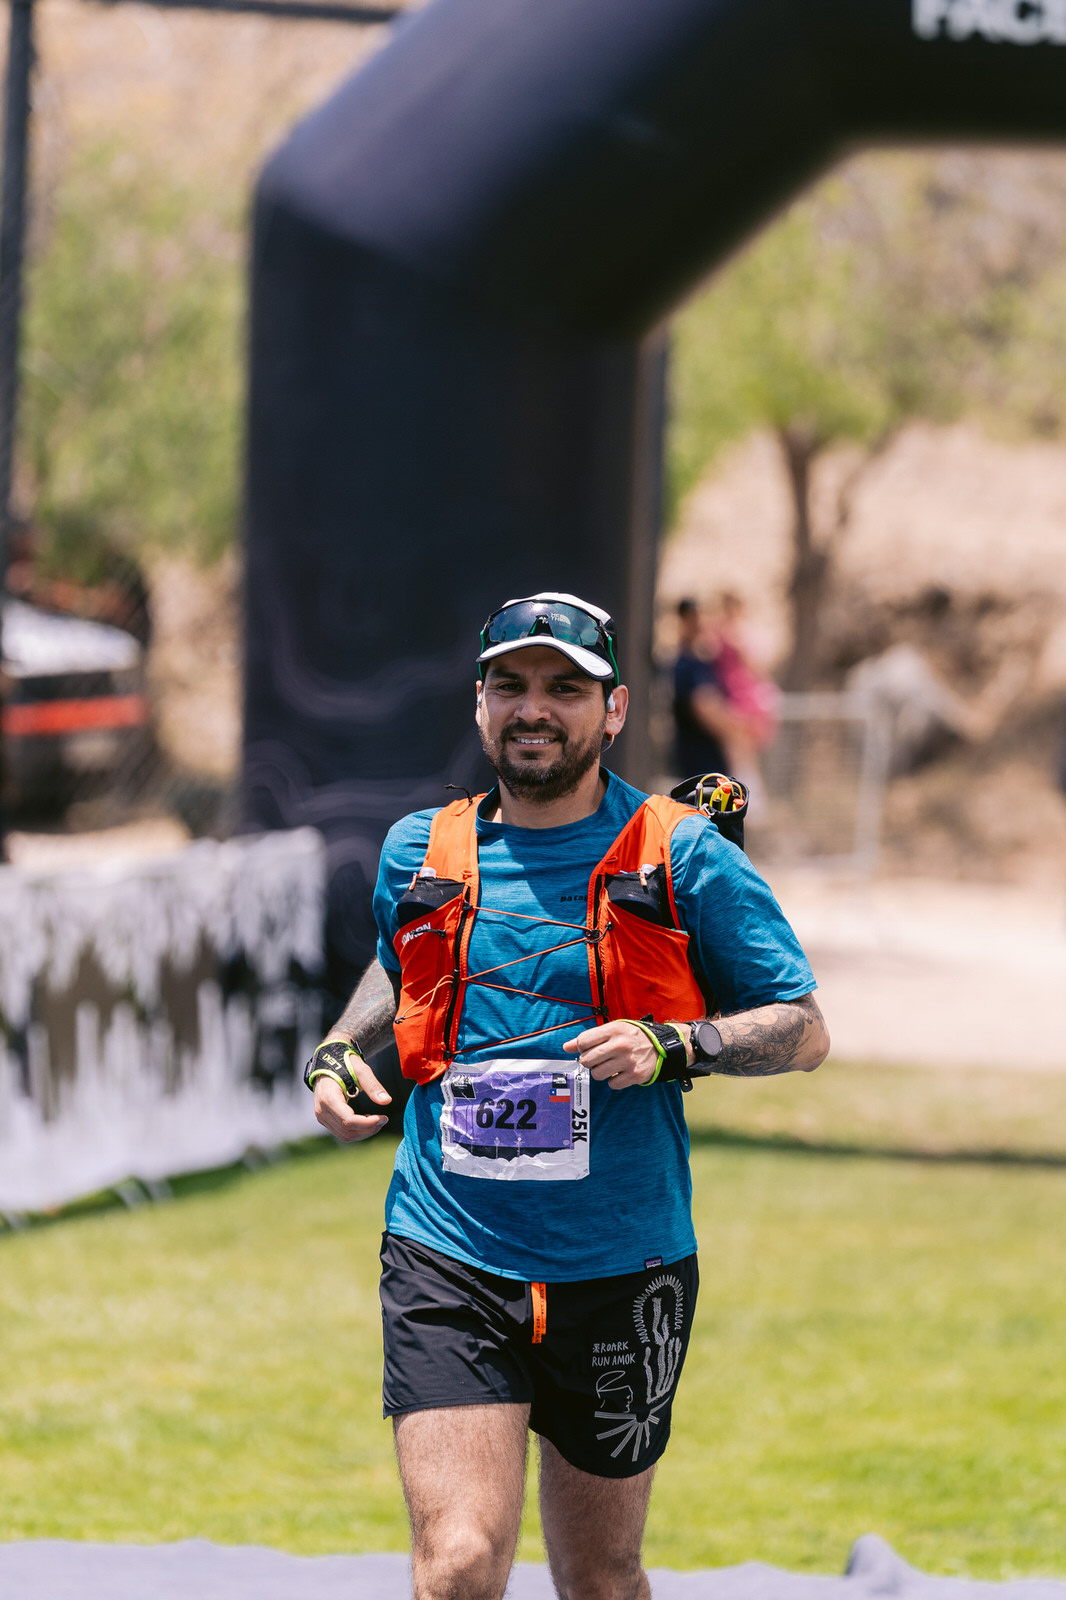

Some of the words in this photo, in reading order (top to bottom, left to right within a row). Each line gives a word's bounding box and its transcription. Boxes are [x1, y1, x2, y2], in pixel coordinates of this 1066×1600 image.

[322, 1053, 342, 1070] LEKI
[476, 1097, 538, 1130] 622
[571, 1109, 588, 1143] 25K
[600, 1341, 629, 1353] ROARK
[592, 1355, 611, 1367] RUN
[611, 1352, 636, 1366] AMOK
